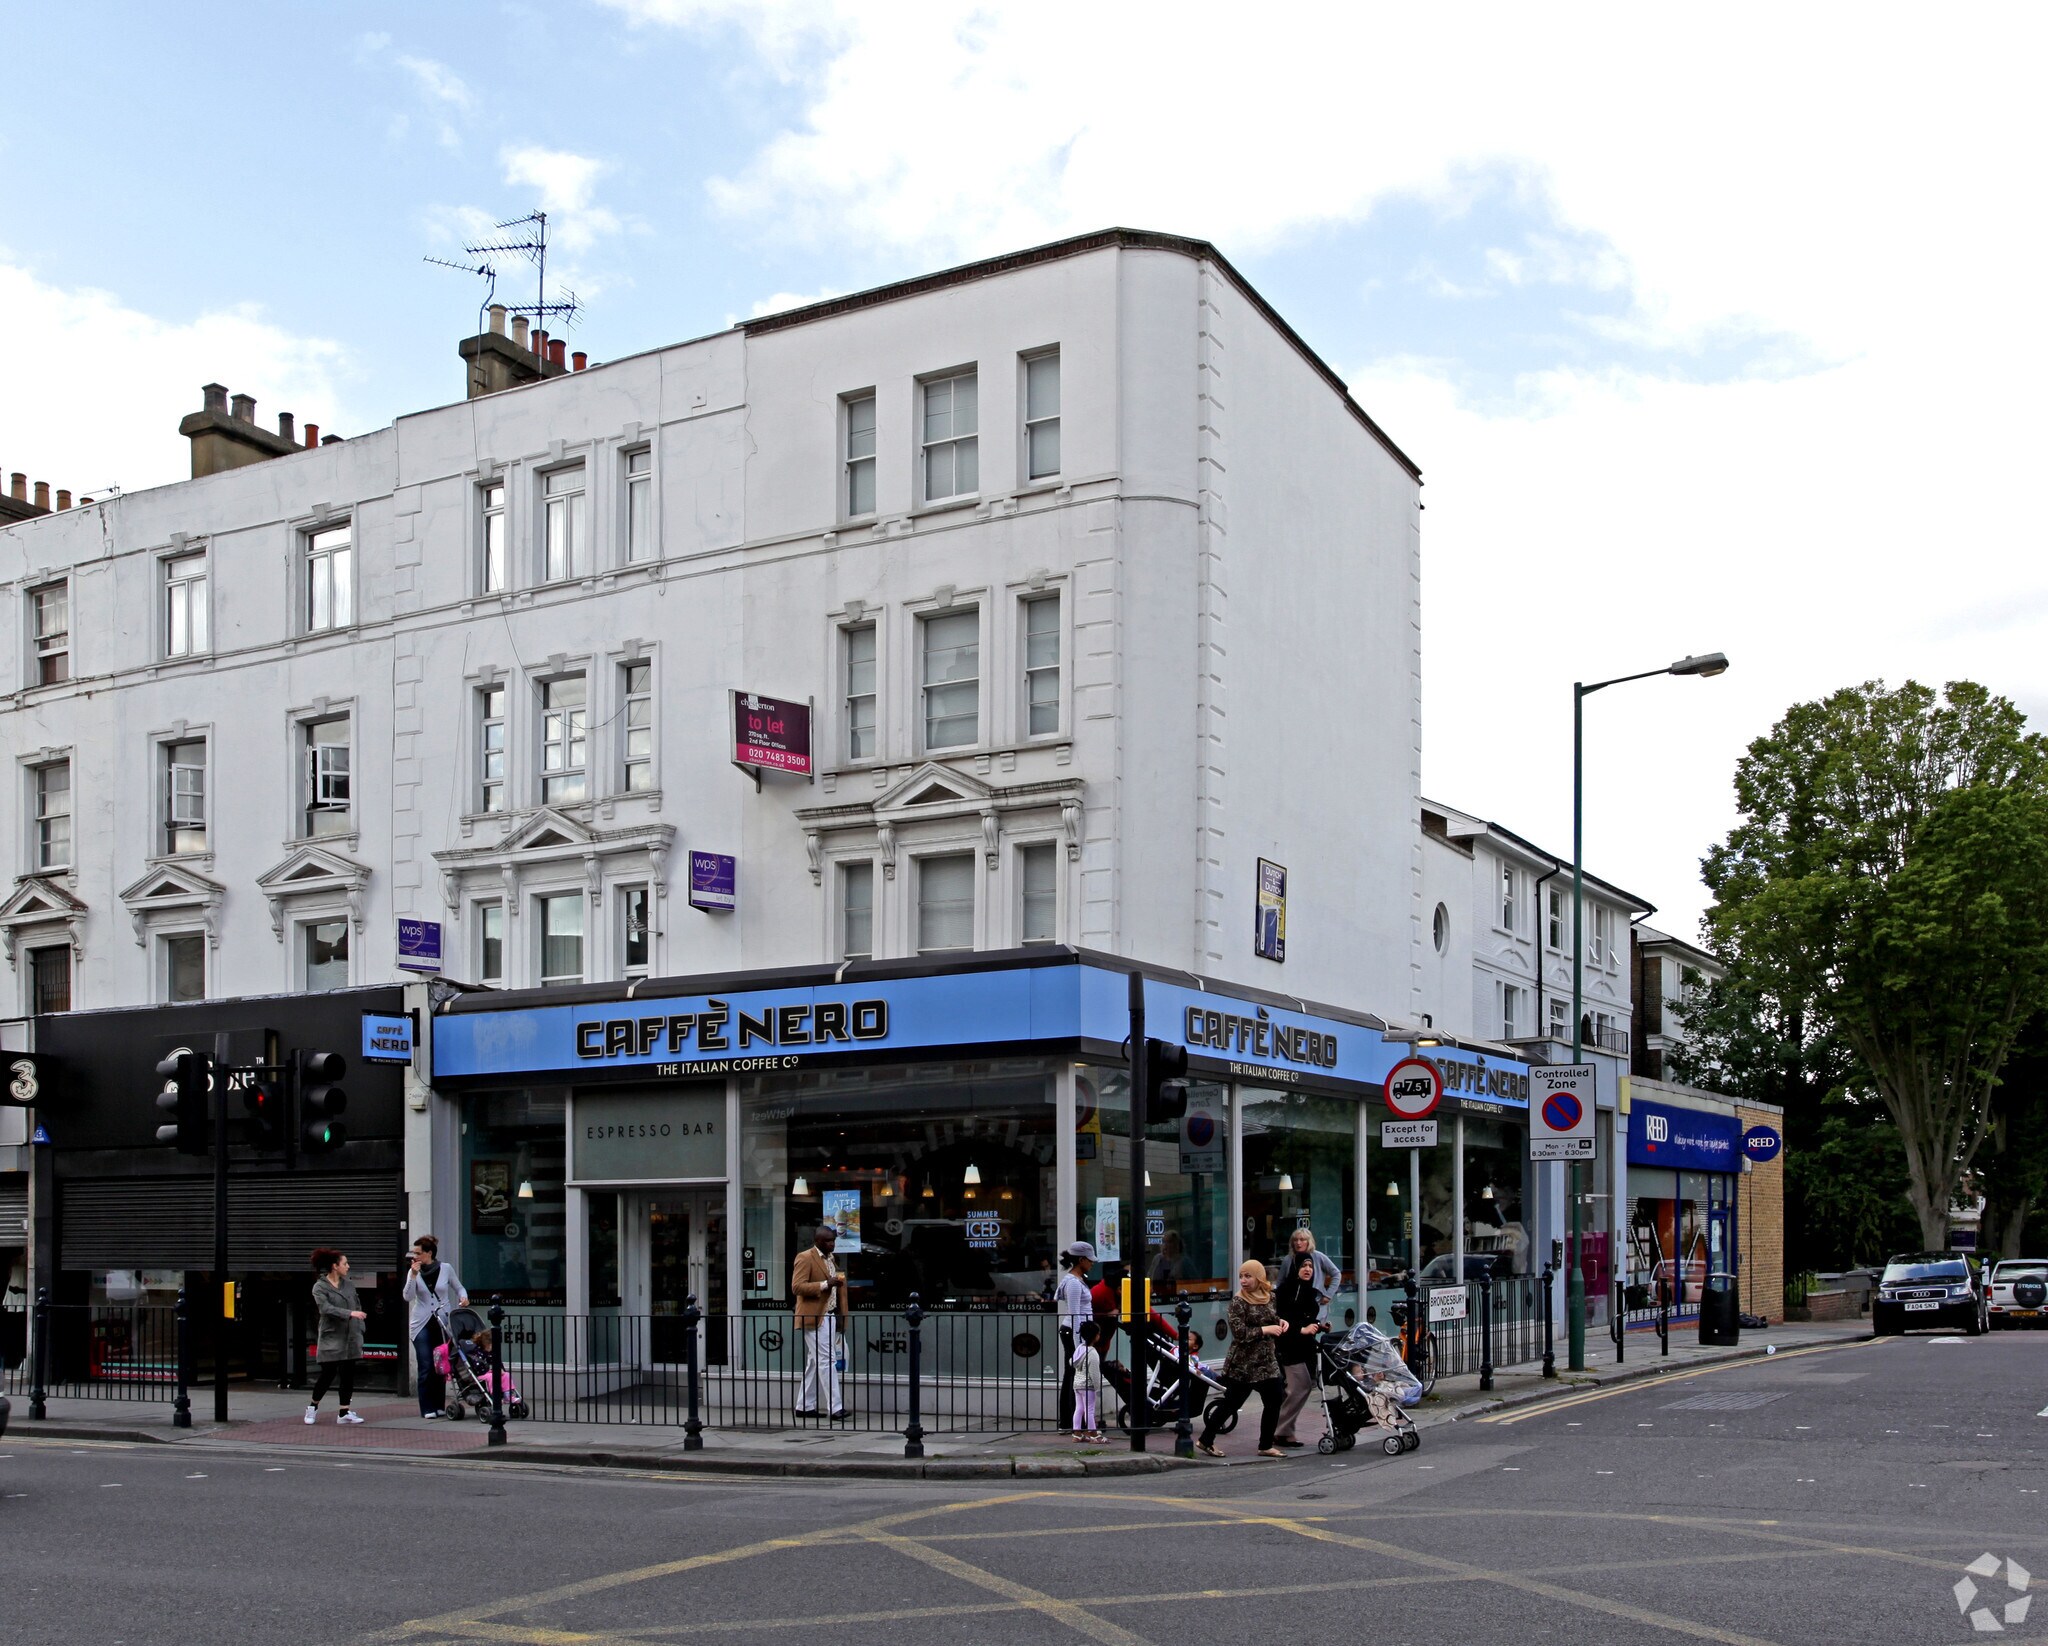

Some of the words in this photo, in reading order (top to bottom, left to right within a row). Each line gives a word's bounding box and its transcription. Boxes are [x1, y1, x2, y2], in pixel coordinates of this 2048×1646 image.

[740, 698, 775, 711] cherton
[748, 714, 762, 730] to
[767, 716, 784, 734] let
[748, 748, 764, 758] 020
[766, 751, 785, 762] 7483
[787, 755, 806, 766] 3500
[694, 858, 716, 871] wps
[1265, 866, 1282, 880] DUTCH
[1265, 882, 1281, 896] DUTCH
[402, 926, 422, 938] wps
[576, 998, 728, 1058] CAFFÈ
[738, 999, 888, 1047] NERO
[1185, 1005, 1270, 1056] CAFFÈ
[1272, 1022, 1338, 1068] NERO
[370, 1037, 410, 1052] NERO
[656, 1062, 678, 1076] THE
[682, 1060, 729, 1074] ITALIAN
[732, 1057, 778, 1072] COFFEE
[1230, 1062, 1242, 1074] THE
[1242, 1064, 1267, 1077] ITALIAN
[1268, 1068, 1290, 1081] COFFEE
[1534, 1068, 1589, 1078] Controlled
[10, 1059, 39, 1101] 3
[1486, 1069, 1528, 1102] NERO
[1547, 1080, 1576, 1089] Zone
[1460, 1099, 1468, 1108] THE
[1484, 1102, 1498, 1113] COFFEE
[588, 1124, 671, 1139] ESPRESSO
[683, 1122, 714, 1136] BAR
[1385, 1124, 1417, 1134] Except
[1421, 1124, 1434, 1132] for
[1646, 1114, 1668, 1142] REED
[1748, 1138, 1774, 1148] REED
[826, 1199, 856, 1211] LATTE
[967, 1210, 998, 1218] SUMMER
[966, 1222, 1000, 1237] ICED
[1146, 1220, 1164, 1234] ICED
[1296, 1217, 1310, 1230] ICED
[1404, 1220, 1412, 1232] ICE
[1430, 1294, 1464, 1307] BRONDESBURY
[1440, 1307, 1454, 1317] ROAD
[501, 1332, 537, 1344] ERO
[868, 1340, 913, 1353] NER
